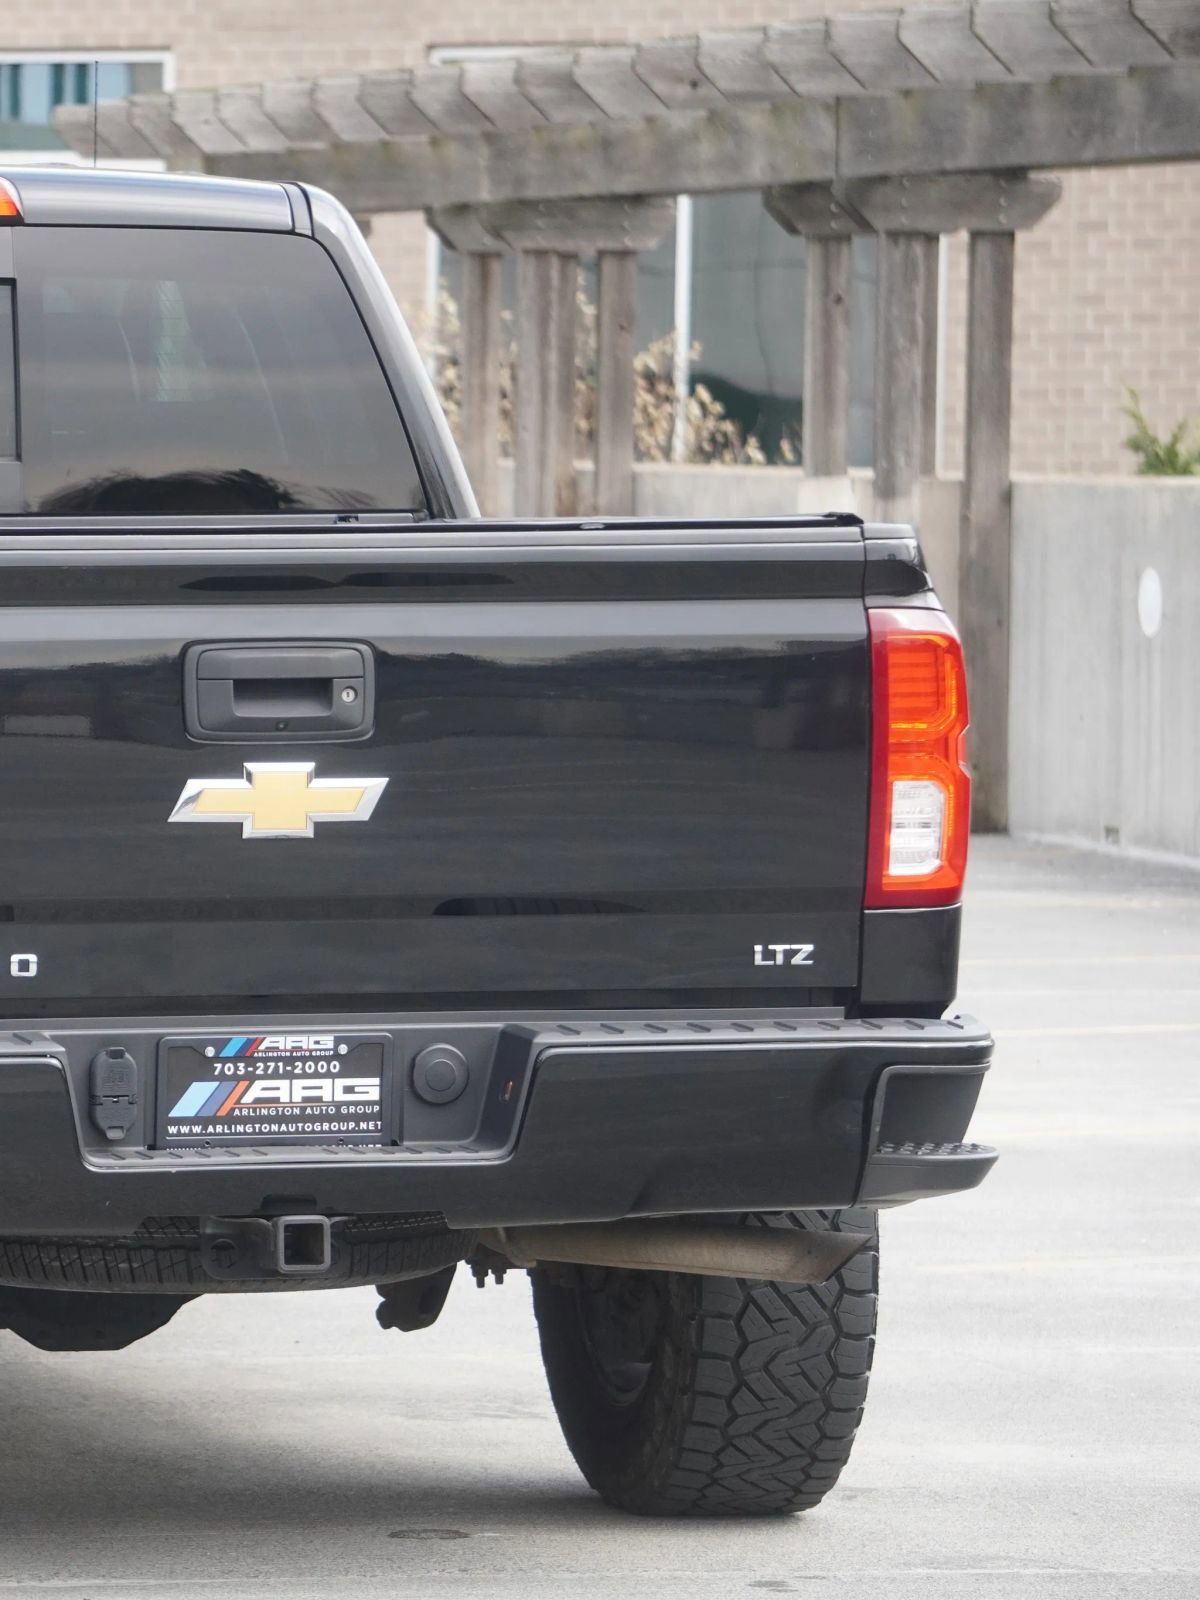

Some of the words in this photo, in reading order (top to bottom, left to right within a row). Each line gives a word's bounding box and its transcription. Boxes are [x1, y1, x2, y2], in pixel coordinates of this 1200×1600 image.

[753, 944, 815, 966] LTZ
[213, 1061, 340, 1075] 703-271-2000
[233, 1107, 300, 1116] ARLINGTON
[305, 1106, 335, 1115] AUTO
[340, 1105, 380, 1114] GROUP
[167, 1121, 382, 1134] WWW.ARLINGTONAUTOGROUP.NET
